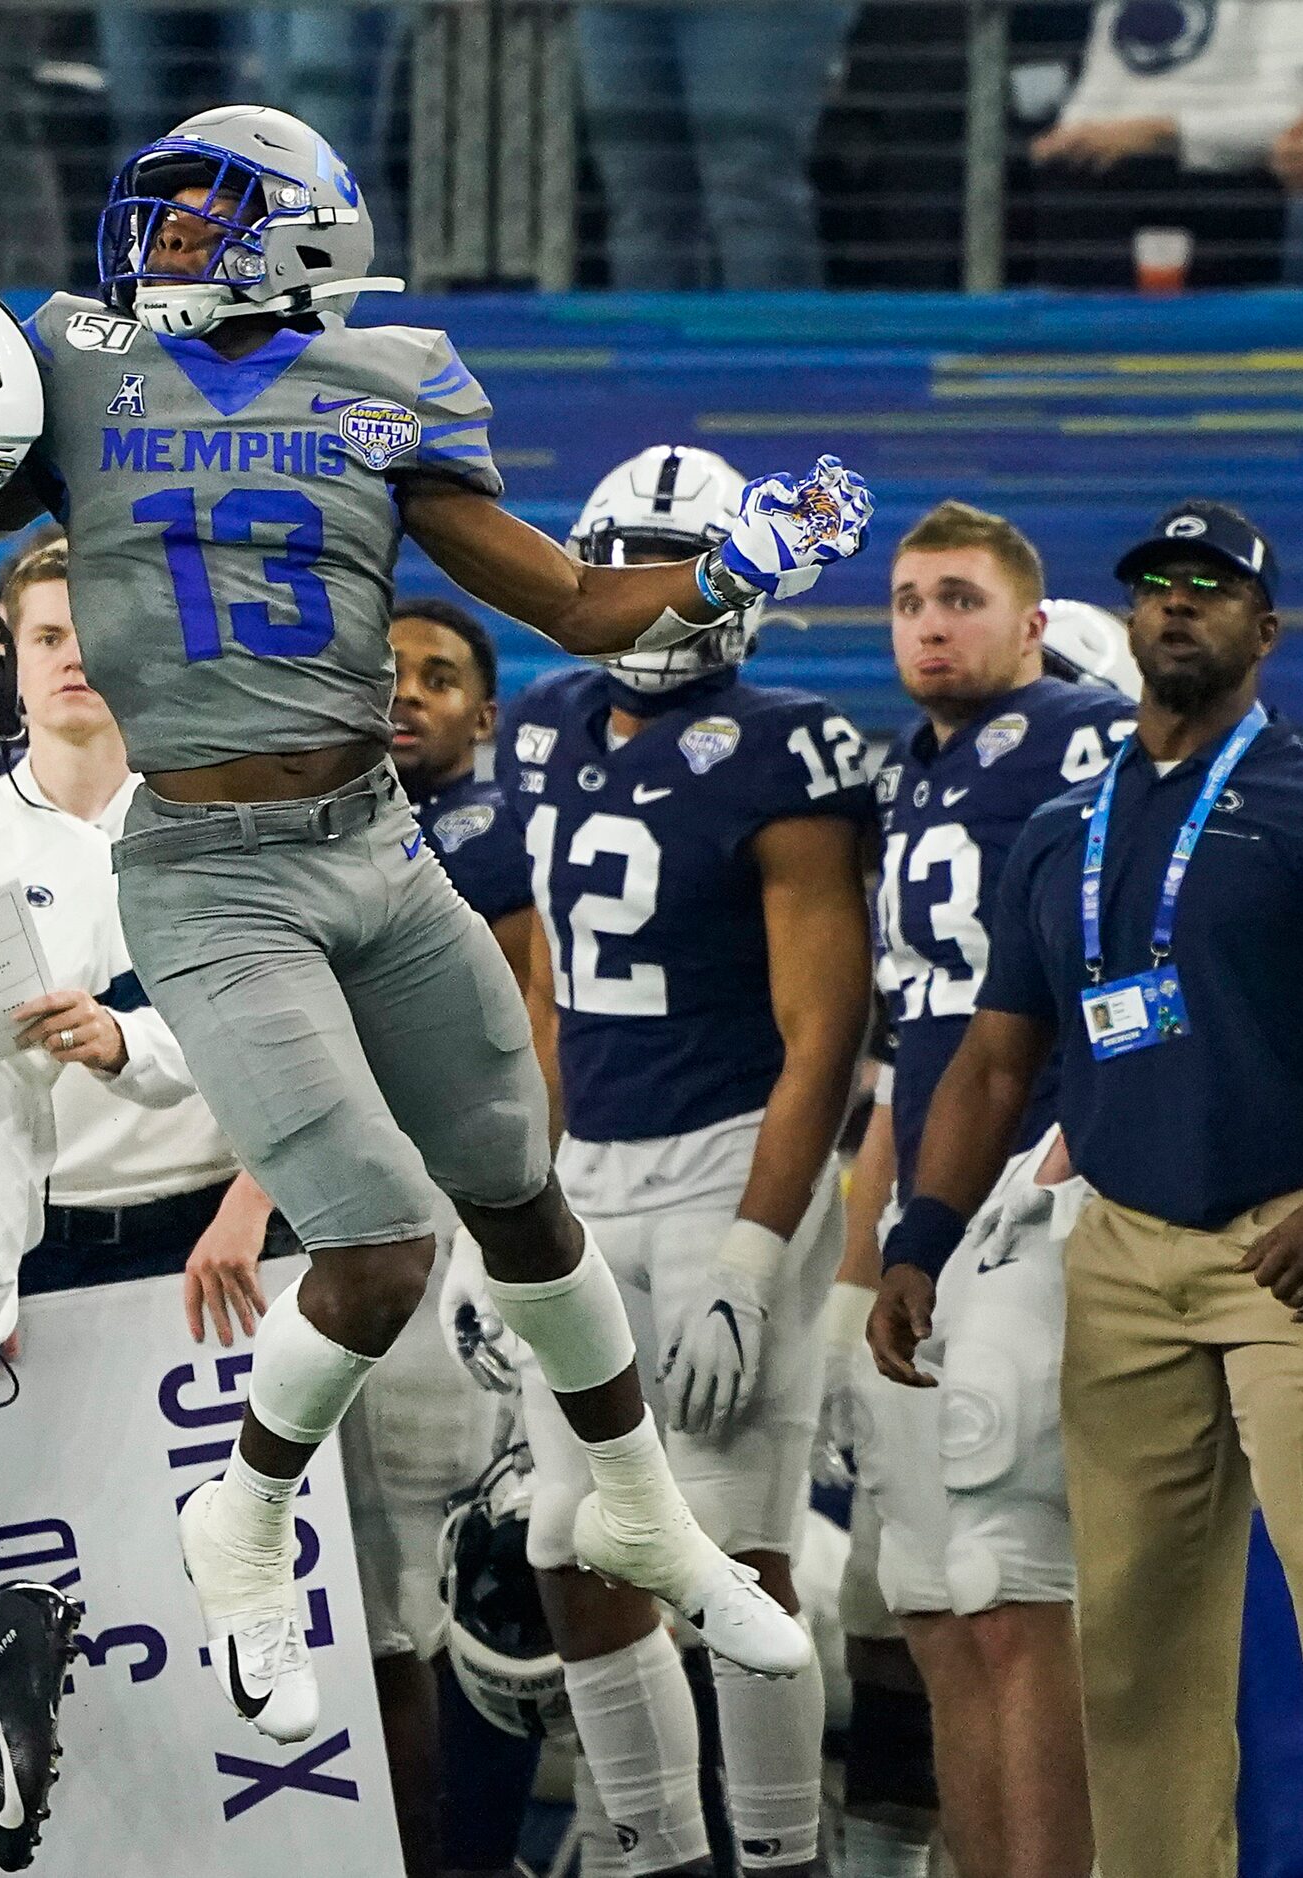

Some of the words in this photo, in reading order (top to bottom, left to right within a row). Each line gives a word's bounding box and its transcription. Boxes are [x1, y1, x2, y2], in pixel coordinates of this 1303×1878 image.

[66, 312, 142, 354] 150
[347, 417, 414, 444] COTTON
[349, 408, 414, 421] GOODYEAR
[357, 430, 401, 447] BOWL
[99, 427, 347, 476] MEMPHIS
[132, 487, 335, 663] 13
[786, 716, 868, 800] 12
[525, 804, 668, 1016] 12
[214, 1728, 359, 1822] X
